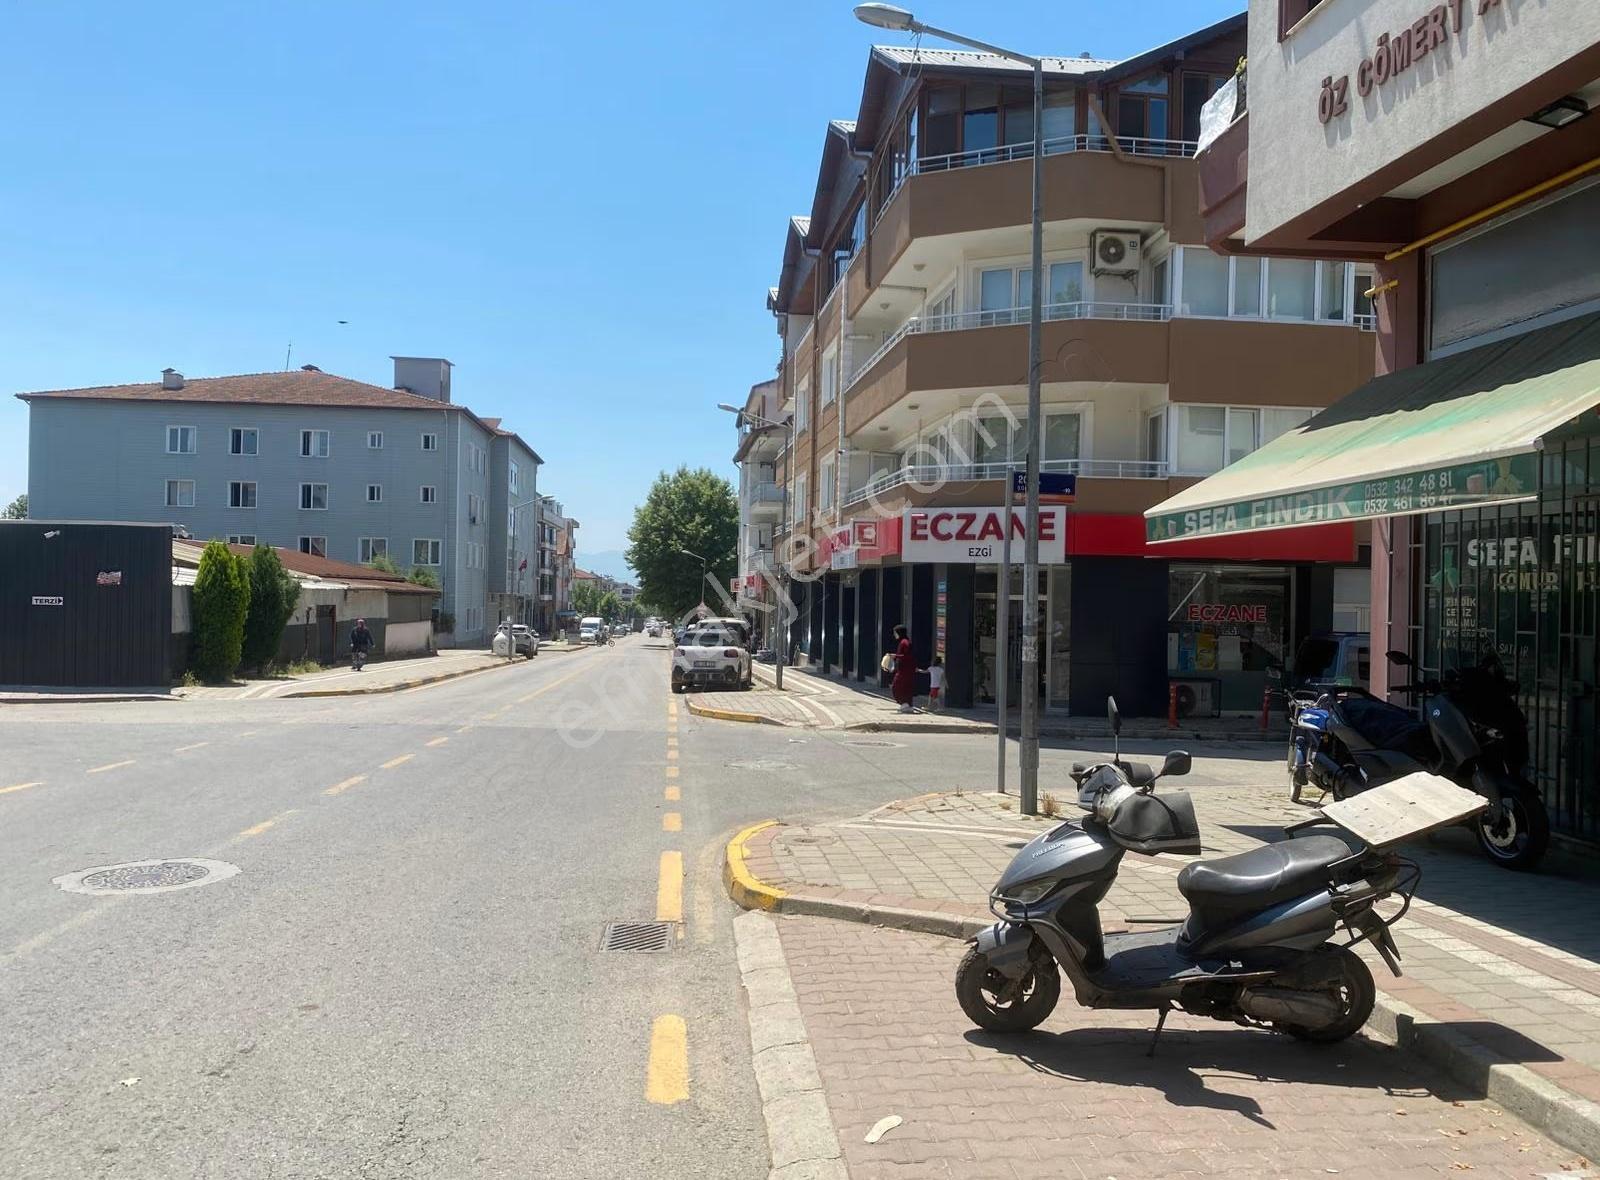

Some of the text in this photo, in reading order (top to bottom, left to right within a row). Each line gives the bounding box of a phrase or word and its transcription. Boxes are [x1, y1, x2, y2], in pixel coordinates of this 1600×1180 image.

[1318, 0, 1464, 124] ÖZ CÖMERT
[1364, 471, 1453, 499] 0532 342 48 81
[1184, 486, 1352, 534] SEFA FINDIK
[1364, 499, 1388, 513] 0532
[1393, 494, 1413, 510] 461
[910, 512, 1056, 541] ECZANE
[968, 545, 992, 557] EZGİ
[1467, 537, 1538, 567] SEFA
[1188, 604, 1267, 622] ECZANE
